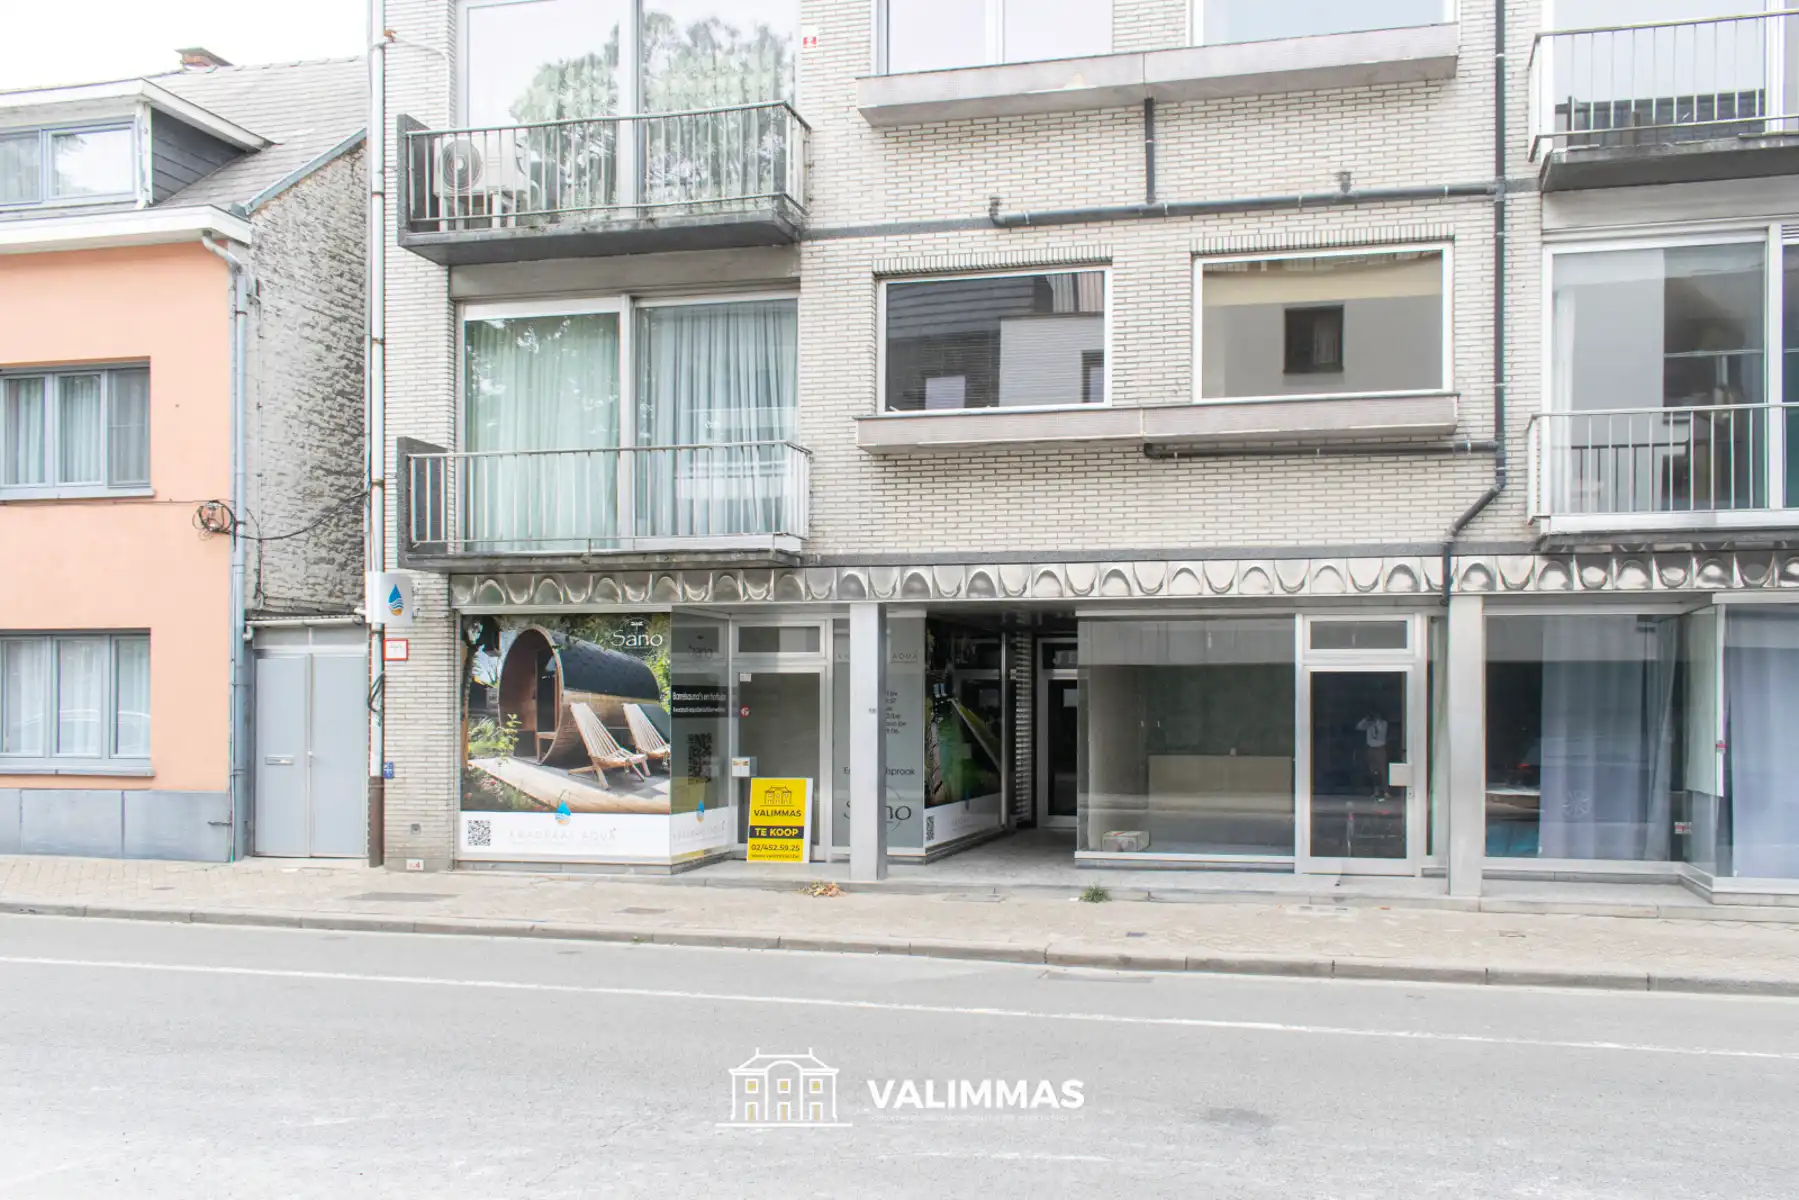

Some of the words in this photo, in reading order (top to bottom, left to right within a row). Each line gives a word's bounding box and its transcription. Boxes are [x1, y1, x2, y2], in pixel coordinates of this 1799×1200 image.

[611, 630, 663, 647] Sano
[892, 652, 917, 660] AQUA
[753, 809, 802, 817] VALIMMAS
[755, 827, 767, 836] TE
[770, 828, 799, 837] KOOP
